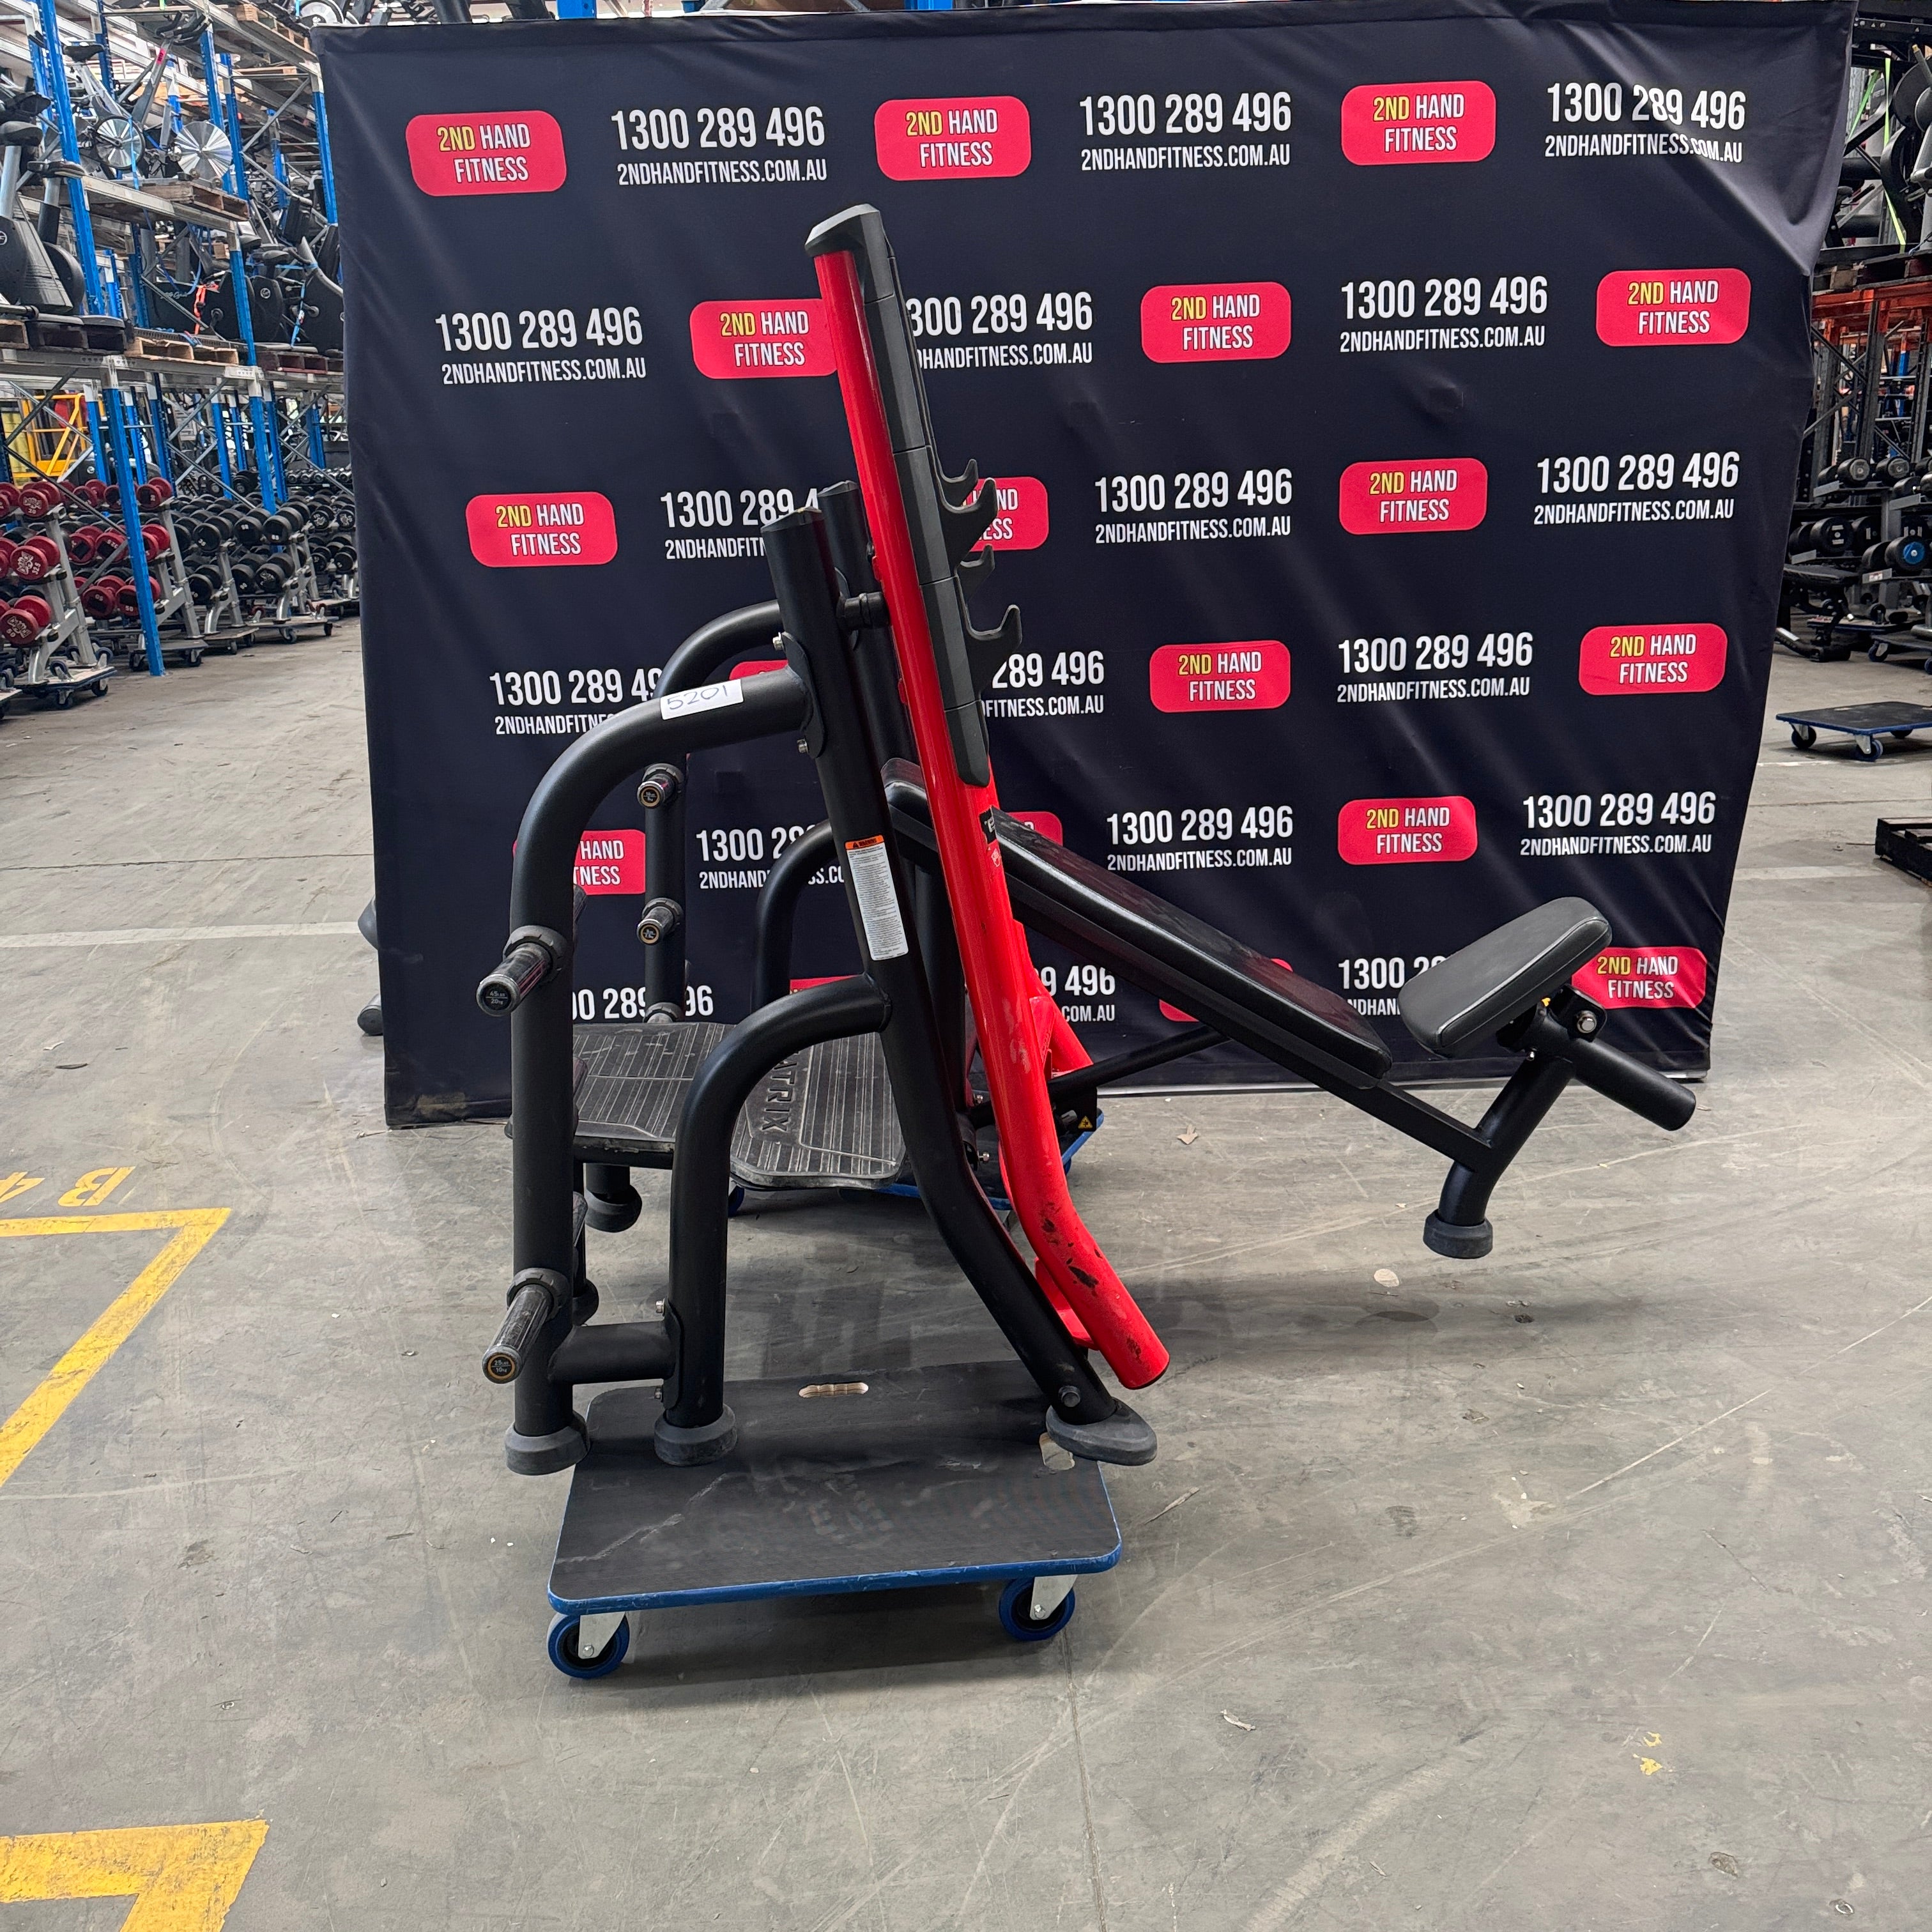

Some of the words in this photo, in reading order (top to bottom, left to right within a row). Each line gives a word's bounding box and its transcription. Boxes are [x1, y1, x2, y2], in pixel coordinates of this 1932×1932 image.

[1079, 94, 1156, 135] 1300
[1165, 93, 1223, 134] 289
[1232, 91, 1291, 132] 496
[1374, 96, 1409, 121] 2ND
[1416, 94, 1464, 119] HAND
[1547, 82, 1622, 122] 1300
[1632, 84, 1683, 125] 289
[1690, 90, 1746, 130] 496
[611, 108, 689, 150] 1300
[697, 107, 757, 148] 289
[765, 106, 825, 147] 496
[906, 111, 942, 136] 2ND
[948, 109, 997, 134] HAND
[437, 126, 475, 151] 2ND
[479, 123, 530, 150] HAND
[1385, 126, 1457, 152] FITNESS
[1545, 133, 1742, 163] 2NDHANDFITNESS.COM.AU
[920, 141, 993, 167] FITNESS
[1081, 143, 1290, 171] 2NDHANDFITNESS.COM.AU
[454, 156, 528, 183] FITNESS
[617, 158, 827, 185] 2NDHANDFITNESS.COM.AU
[1341, 279, 1415, 319] 1300
[1425, 277, 1481, 317] 289
[1489, 275, 1547, 314] 496
[1628, 282, 1664, 305] 2ND
[1670, 280, 1719, 303] HAND
[906, 296, 962, 337] 300
[970, 294, 1027, 334] 289
[1036, 291, 1092, 331] 496
[1172, 296, 1206, 320] 2ND
[1213, 294, 1260, 319] HAND
[435, 312, 512, 351] 1300
[519, 309, 578, 349] 289
[586, 306, 643, 346] 496
[720, 312, 756, 336] 2ND
[760, 311, 809, 335] HAND
[1639, 310, 1710, 334] FITNESS
[1183, 325, 1253, 350] FITNESS
[1340, 325, 1545, 353] 2NDHANDFITNESS.COM.AU
[734, 342, 805, 367] FITNESS
[441, 357, 647, 385] 2NDHANDFITNESS.COM.AU
[1370, 471, 1404, 494] 2ND
[1410, 470, 1457, 493] HAND
[1537, 456, 1609, 493] 1300
[1618, 453, 1675, 491] 289
[1682, 451, 1740, 488] 496
[1095, 474, 1165, 512] 1300
[1174, 471, 1229, 509] 289
[1237, 468, 1292, 506] 496
[496, 505, 532, 528] 2ND
[536, 503, 584, 526] HAND
[660, 490, 733, 528] 1300
[1380, 498, 1449, 523] FITNESS
[1533, 498, 1734, 525] 2NDHANDFITNESS.COM.AU
[1095, 516, 1291, 544] 2NDHANDFITNESS.COM.AU
[510, 532, 581, 556] FITNESS
[1338, 637, 1407, 673] 1300
[1415, 634, 1469, 670] 289
[1476, 632, 1533, 667] 496
[1610, 636, 1644, 657] 2ND
[1650, 634, 1696, 656] HAND
[1051, 650, 1104, 686] 496
[1179, 654, 1211, 675] 2ND
[1218, 651, 1262, 673] HAND
[1620, 661, 1688, 684] FITNESS
[489, 670, 562, 706] 1300
[568, 668, 623, 703] 289
[667, 684, 728, 710] 5201
[1190, 678, 1255, 702] FITNESS
[1337, 677, 1530, 703] 2NDHANDFITNESS.COM.AU
[1367, 808, 1399, 829] 2ND
[1404, 807, 1450, 827] HAND
[1522, 795, 1591, 829] 1300
[1600, 792, 1653, 827] 289
[1660, 791, 1716, 825] 496
[1107, 809, 1173, 845] 1300
[1181, 808, 1232, 841] 289
[1241, 805, 1293, 839] 496
[579, 840, 624, 860] HAND
[696, 828, 763, 861] 1300
[1377, 832, 1443, 854] FITNESS
[1520, 834, 1712, 856] 2NDHANDFITNESS.COM.AU
[1107, 847, 1292, 871] 2NDHANDFITNESS.COM.AU
[1338, 957, 1405, 990] 1300
[1597, 956, 1630, 975] 2ND
[1636, 956, 1678, 976] HAND
[1064, 965, 1116, 996] 496
[1608, 979, 1675, 999] FITNESS
